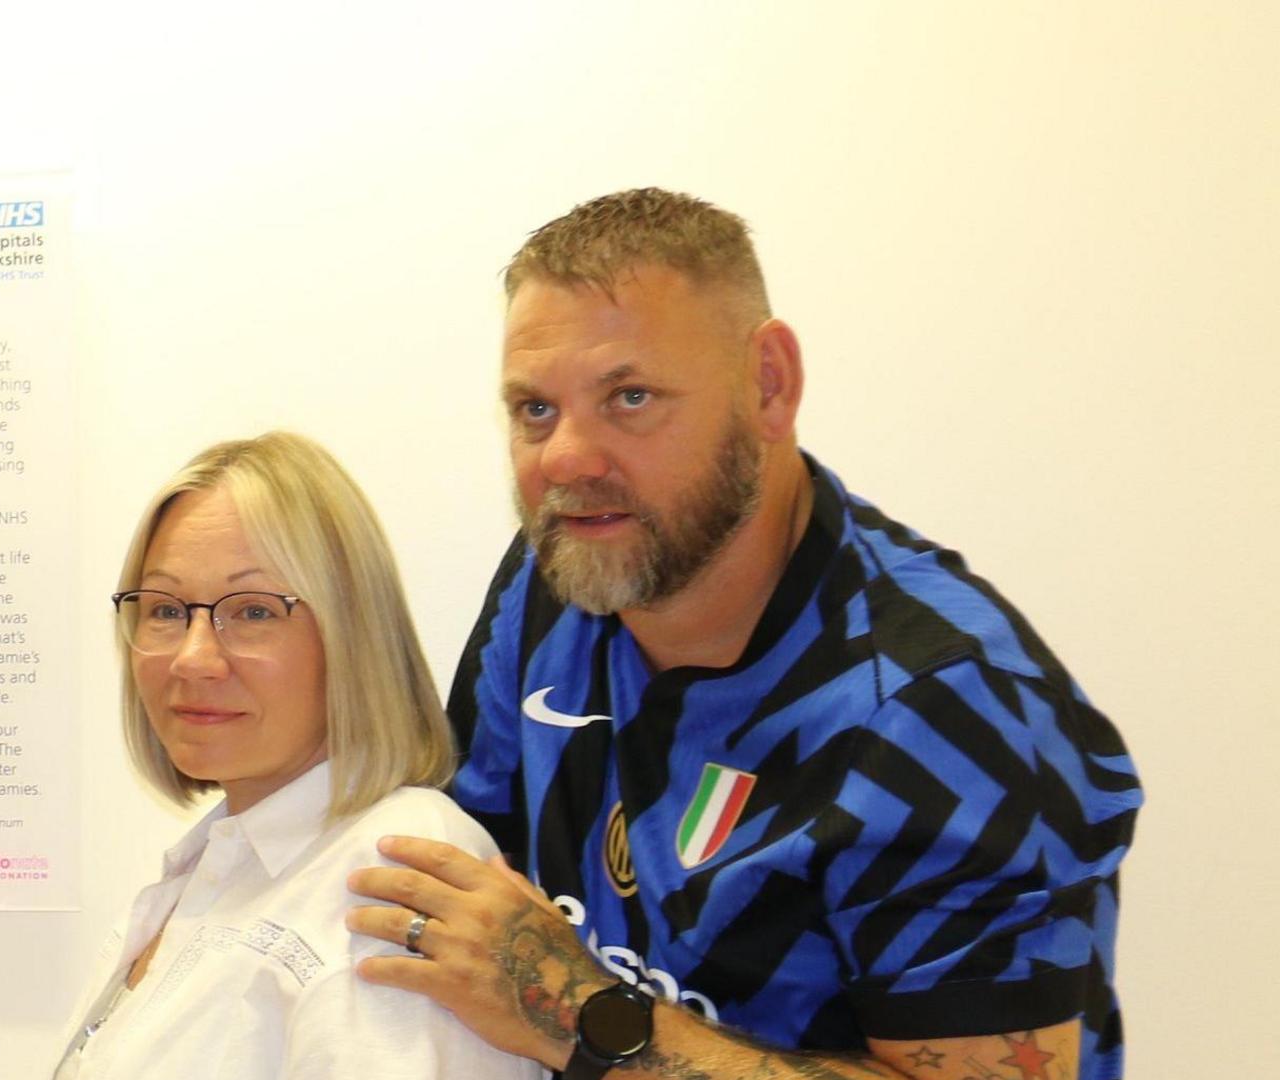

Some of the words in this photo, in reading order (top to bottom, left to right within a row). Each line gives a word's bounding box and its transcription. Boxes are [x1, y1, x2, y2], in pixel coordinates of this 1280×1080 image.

[10, 551, 30, 564] life
[0, 613, 28, 623] was
[10, 671, 36, 684] and
